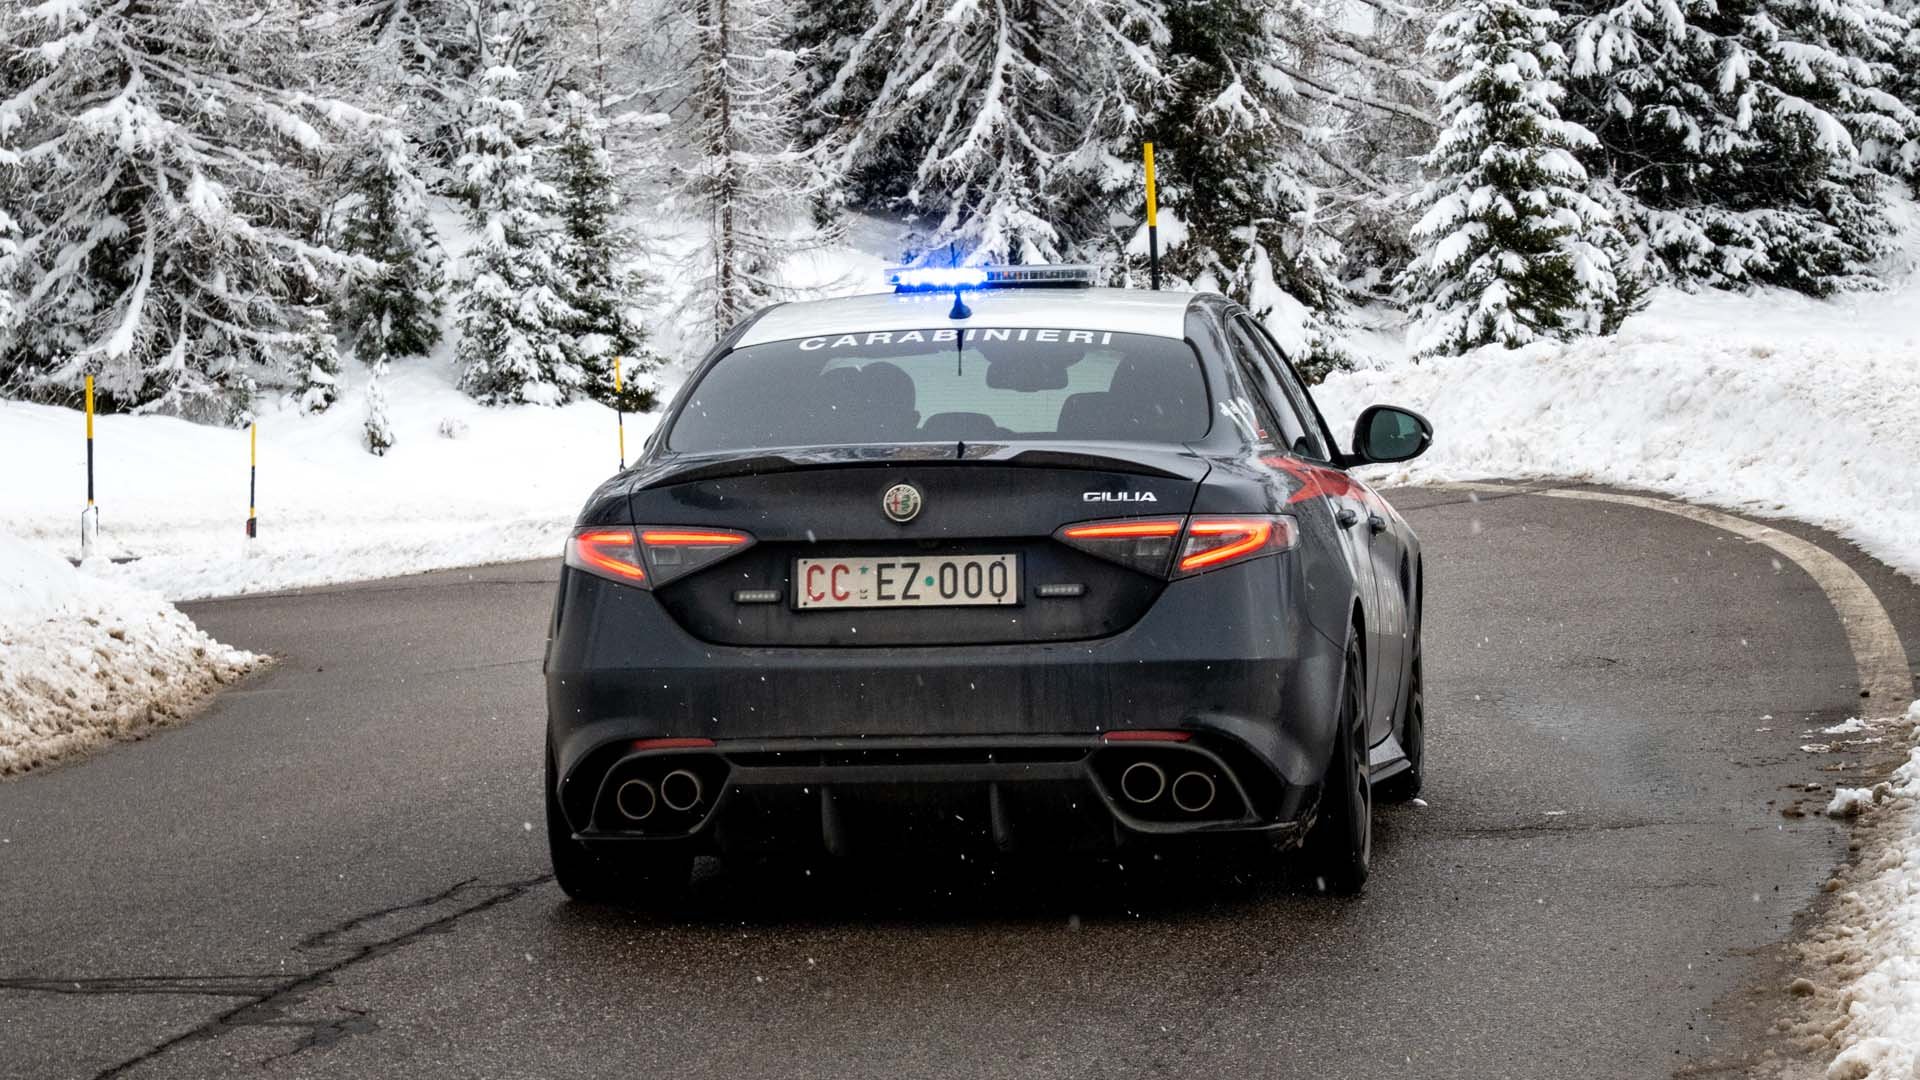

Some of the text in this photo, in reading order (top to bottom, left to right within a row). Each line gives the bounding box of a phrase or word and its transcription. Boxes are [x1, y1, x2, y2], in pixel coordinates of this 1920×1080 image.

[799, 328, 1114, 352] CARABINIERI
[1083, 491, 1157, 502] GIULIA
[806, 563, 850, 602] CC
[877, 562, 921, 601] EZ
